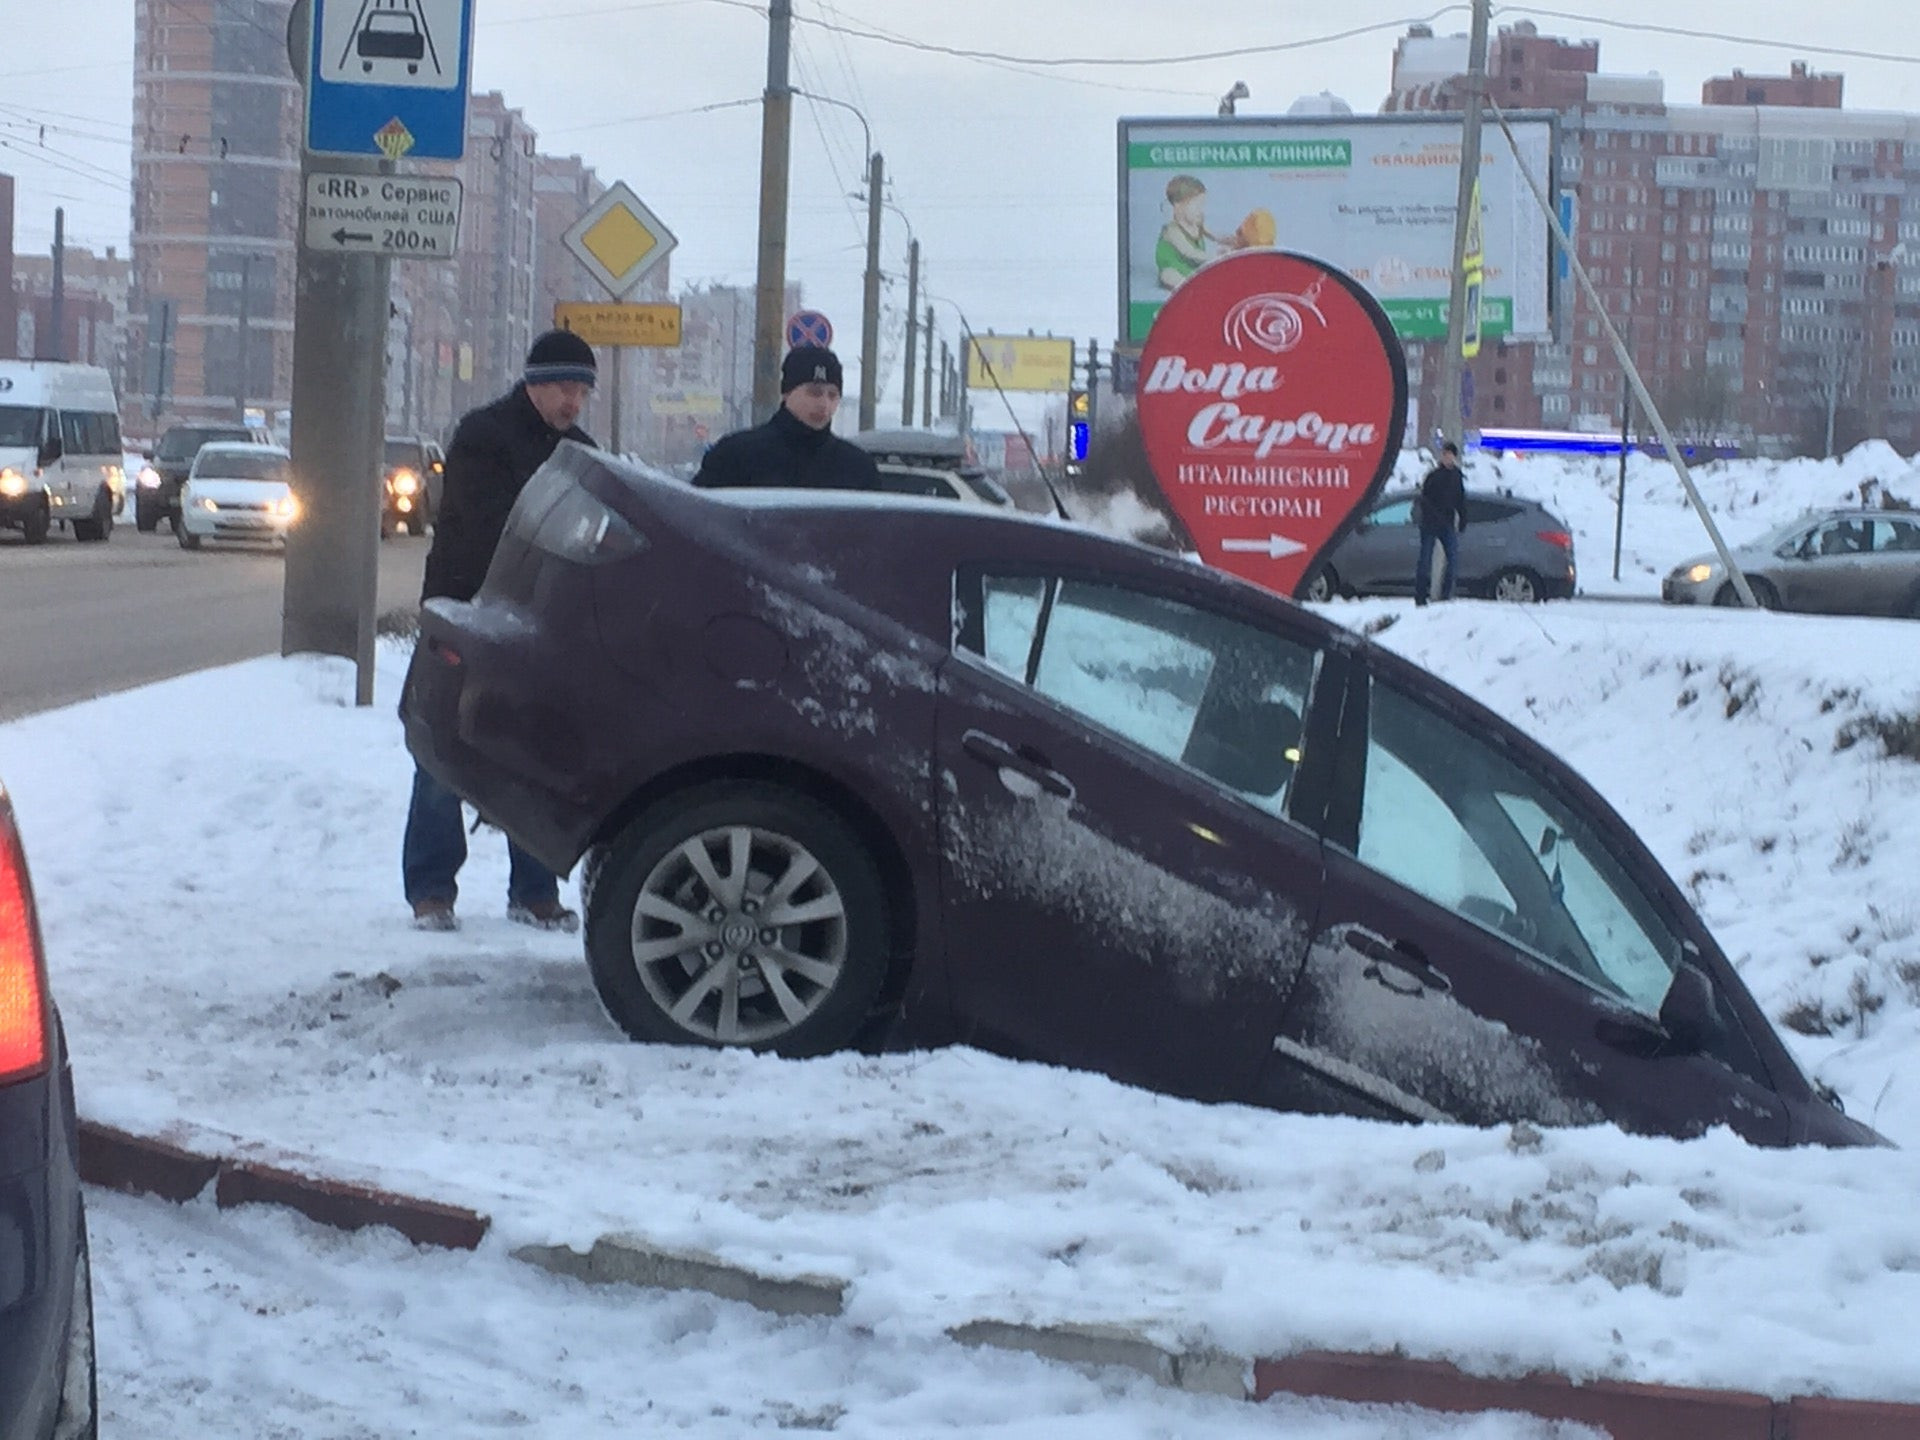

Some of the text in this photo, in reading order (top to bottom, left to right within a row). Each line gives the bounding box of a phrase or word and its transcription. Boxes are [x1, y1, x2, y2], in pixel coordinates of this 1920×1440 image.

[1150, 145, 1347, 162] СЕВЕРНАЯ КЛИНИКА
[381, 182, 450, 205] Сервис
[309, 205, 456, 225] автомобилей США
[1178, 464, 1350, 488] ИТАЛЬЯНСКИЙ
[1204, 495, 1321, 517] РЕСТОРАН
